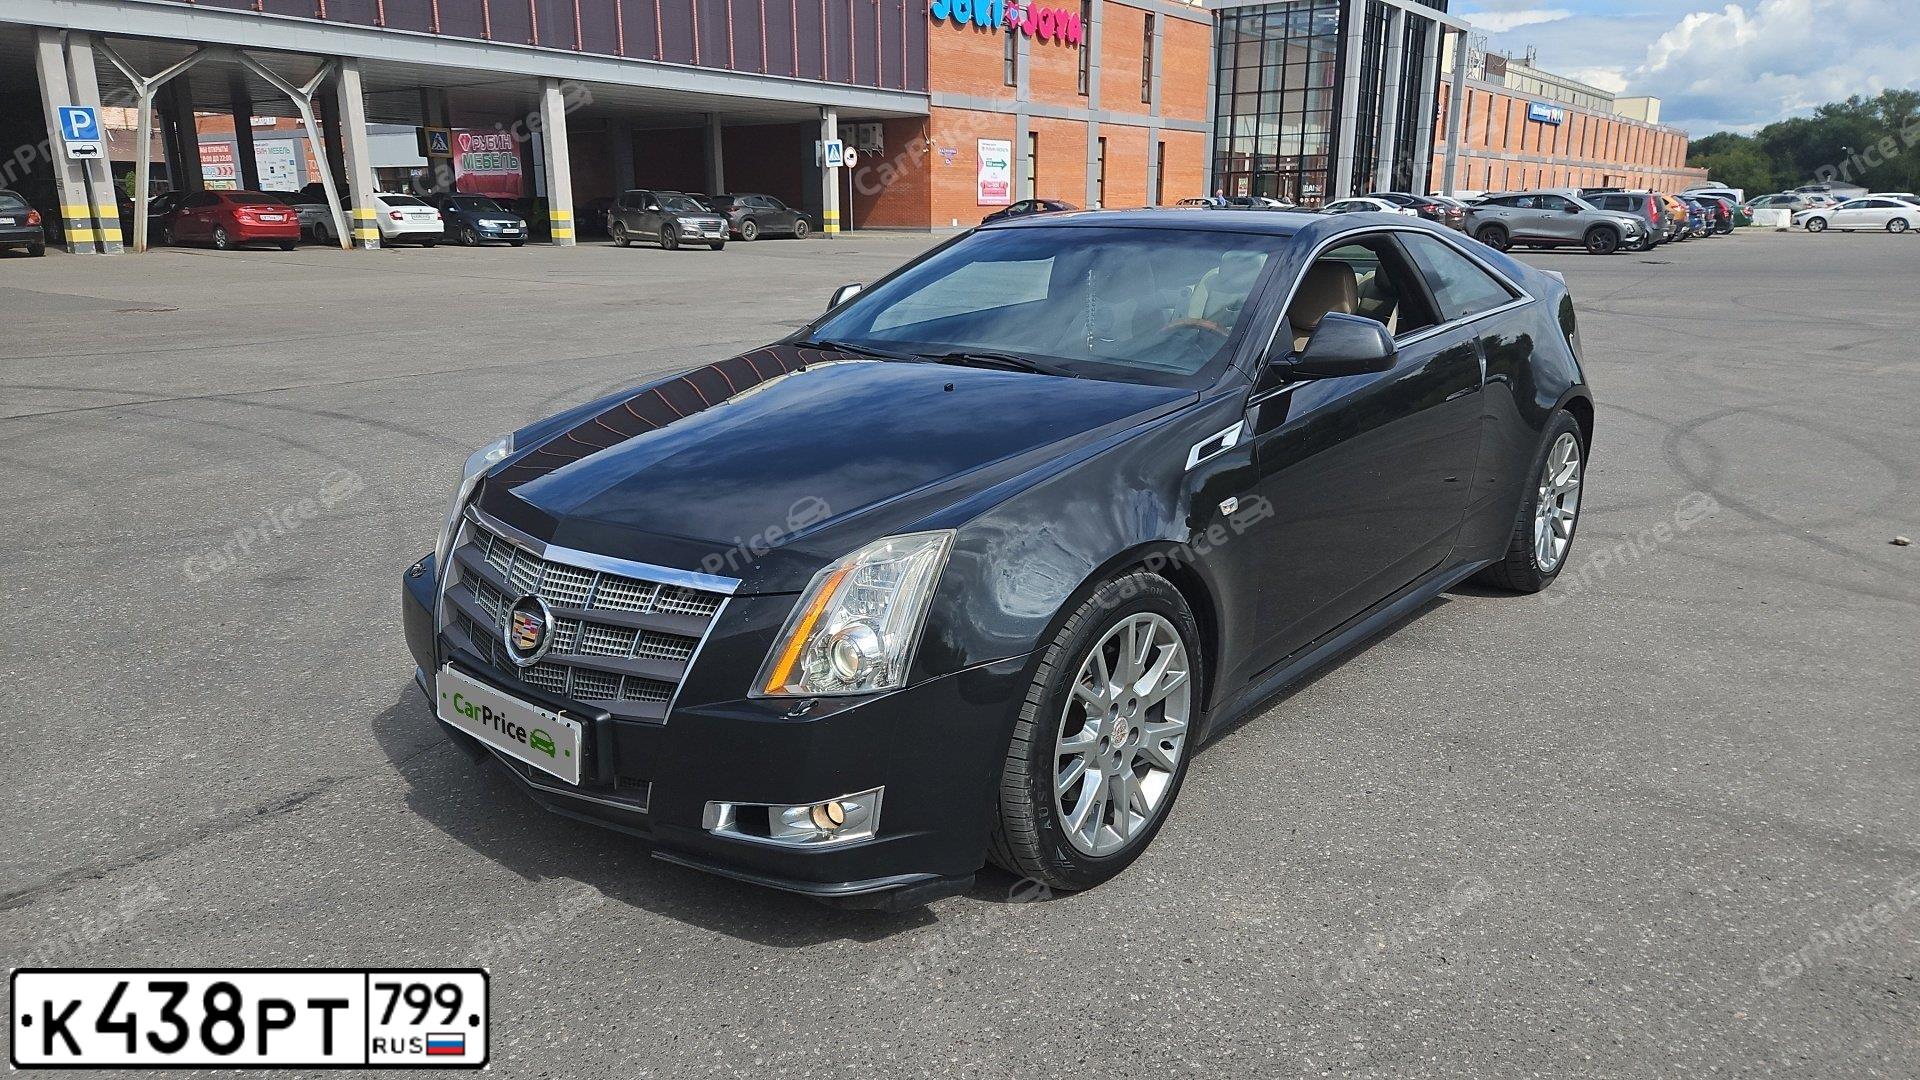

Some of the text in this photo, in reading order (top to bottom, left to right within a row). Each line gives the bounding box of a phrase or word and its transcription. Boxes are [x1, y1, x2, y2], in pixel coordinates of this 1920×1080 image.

[1021, 0, 1083, 44] JOYA
[70, 110, 91, 138] P
[471, 133, 512, 151] РУБИН
[461, 151, 519, 171] МЕБЕЛЬ
